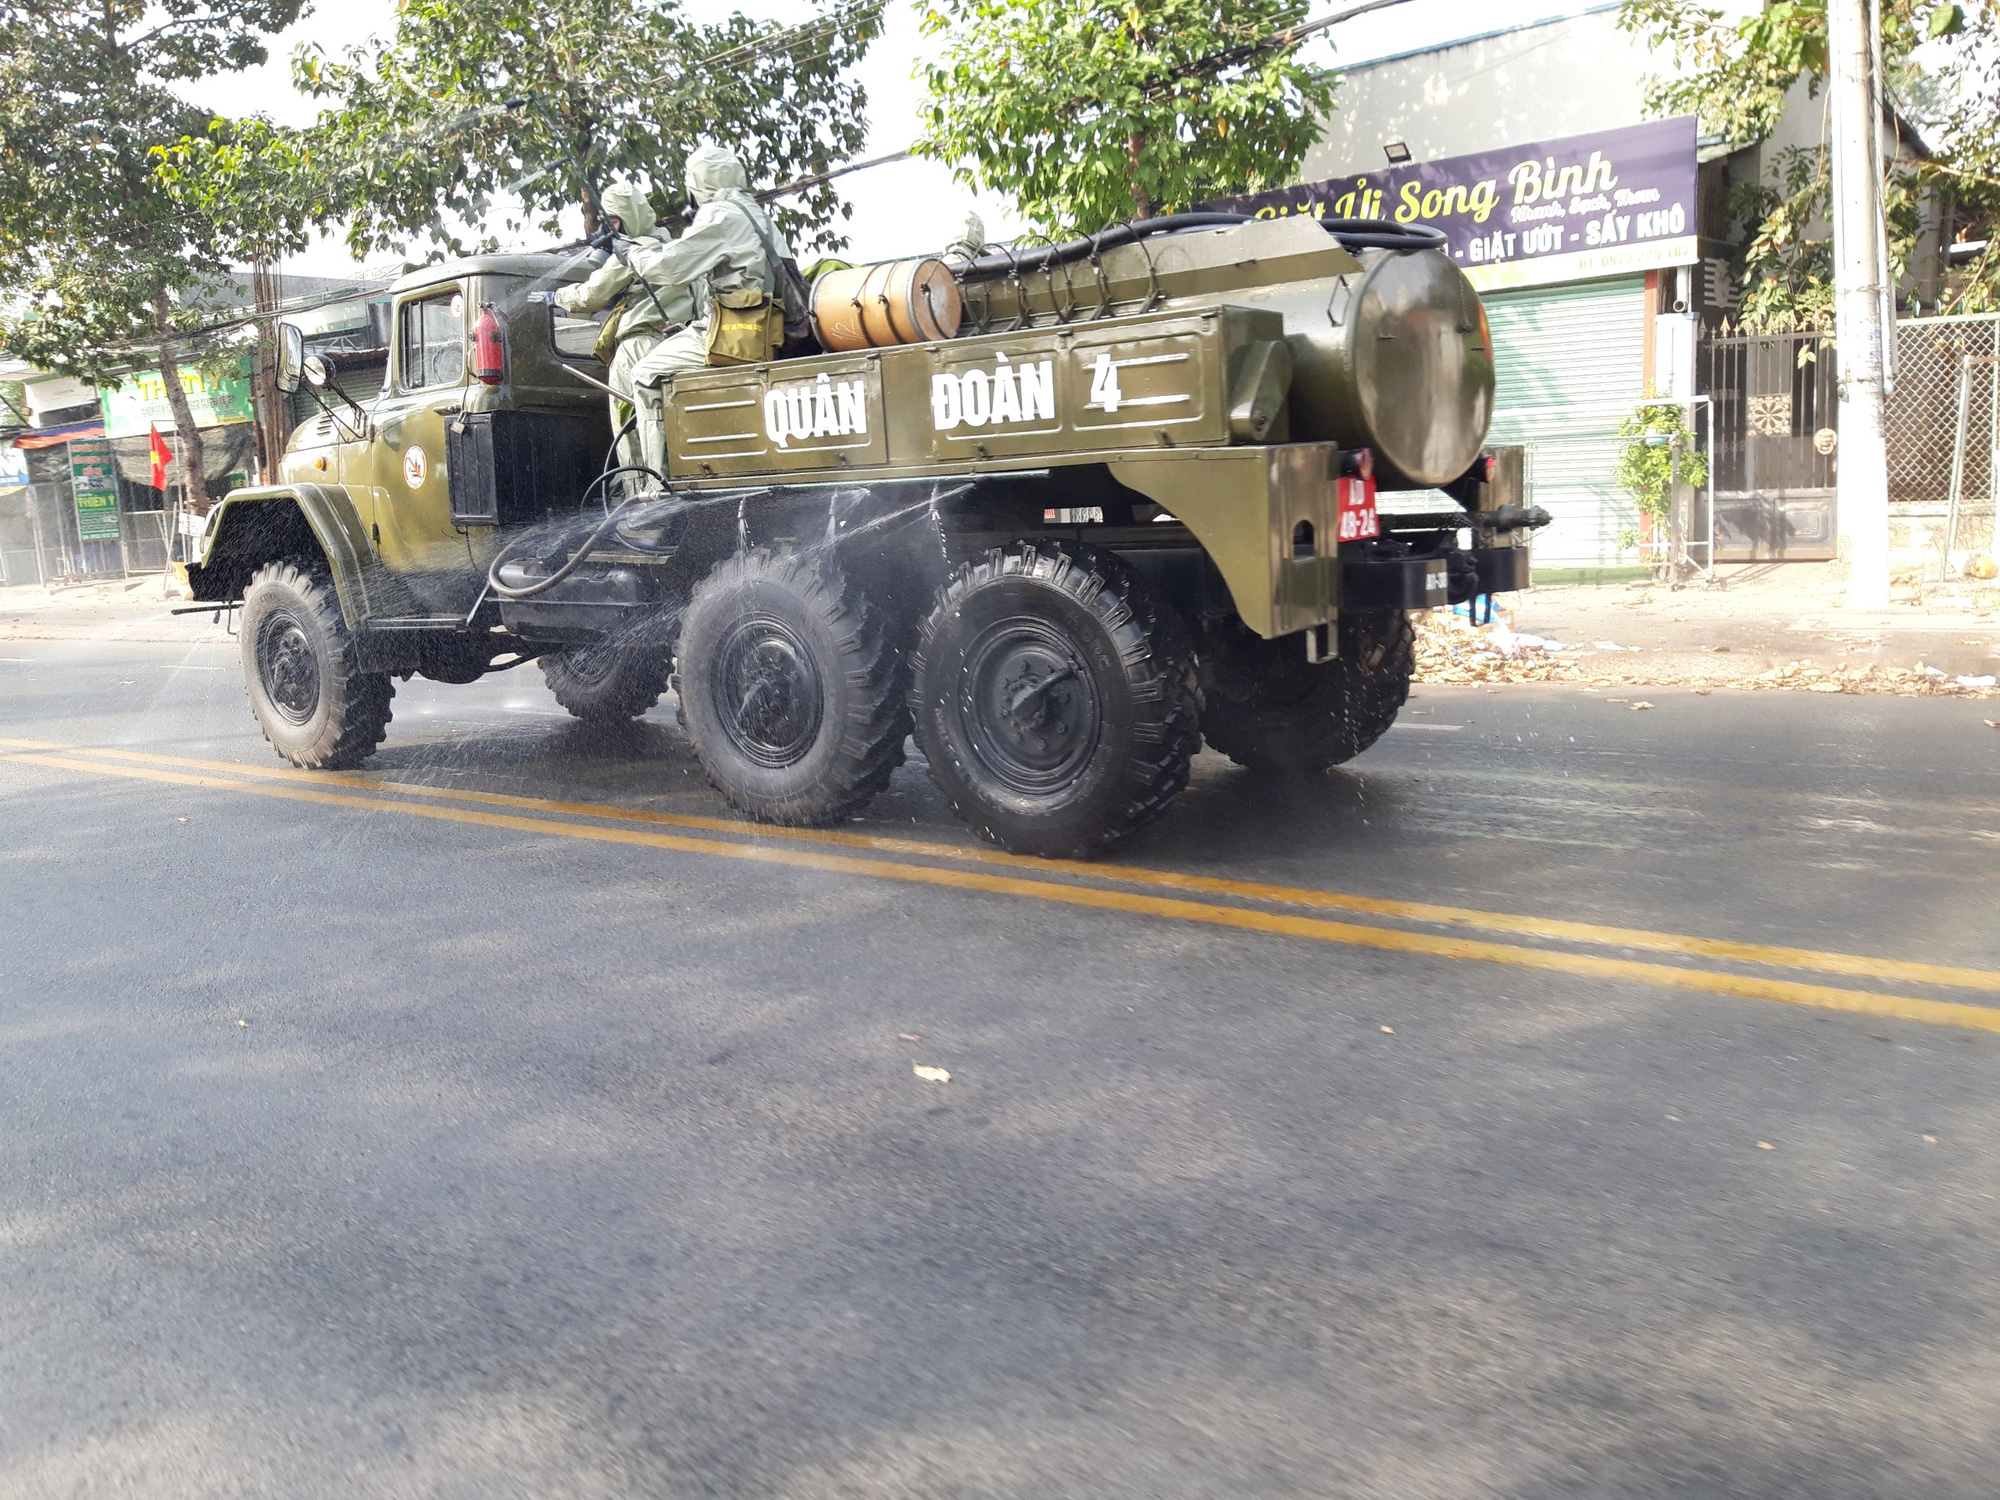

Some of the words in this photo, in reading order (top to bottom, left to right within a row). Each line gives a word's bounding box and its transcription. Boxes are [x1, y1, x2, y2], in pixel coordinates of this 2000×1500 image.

[1394, 179, 1500, 223] Song
[1508, 150, 1618, 205] Bình
[1469, 230, 1517, 264] GIẶT
[1522, 222, 1565, 254] ƯỚT
[1585, 209, 1631, 246] SẤY
[1637, 202, 1685, 239] KHÔ
[763, 373, 867, 447] QUÂN
[931, 352, 1056, 431] ĐOÀN
[1090, 354, 1121, 413] 4
